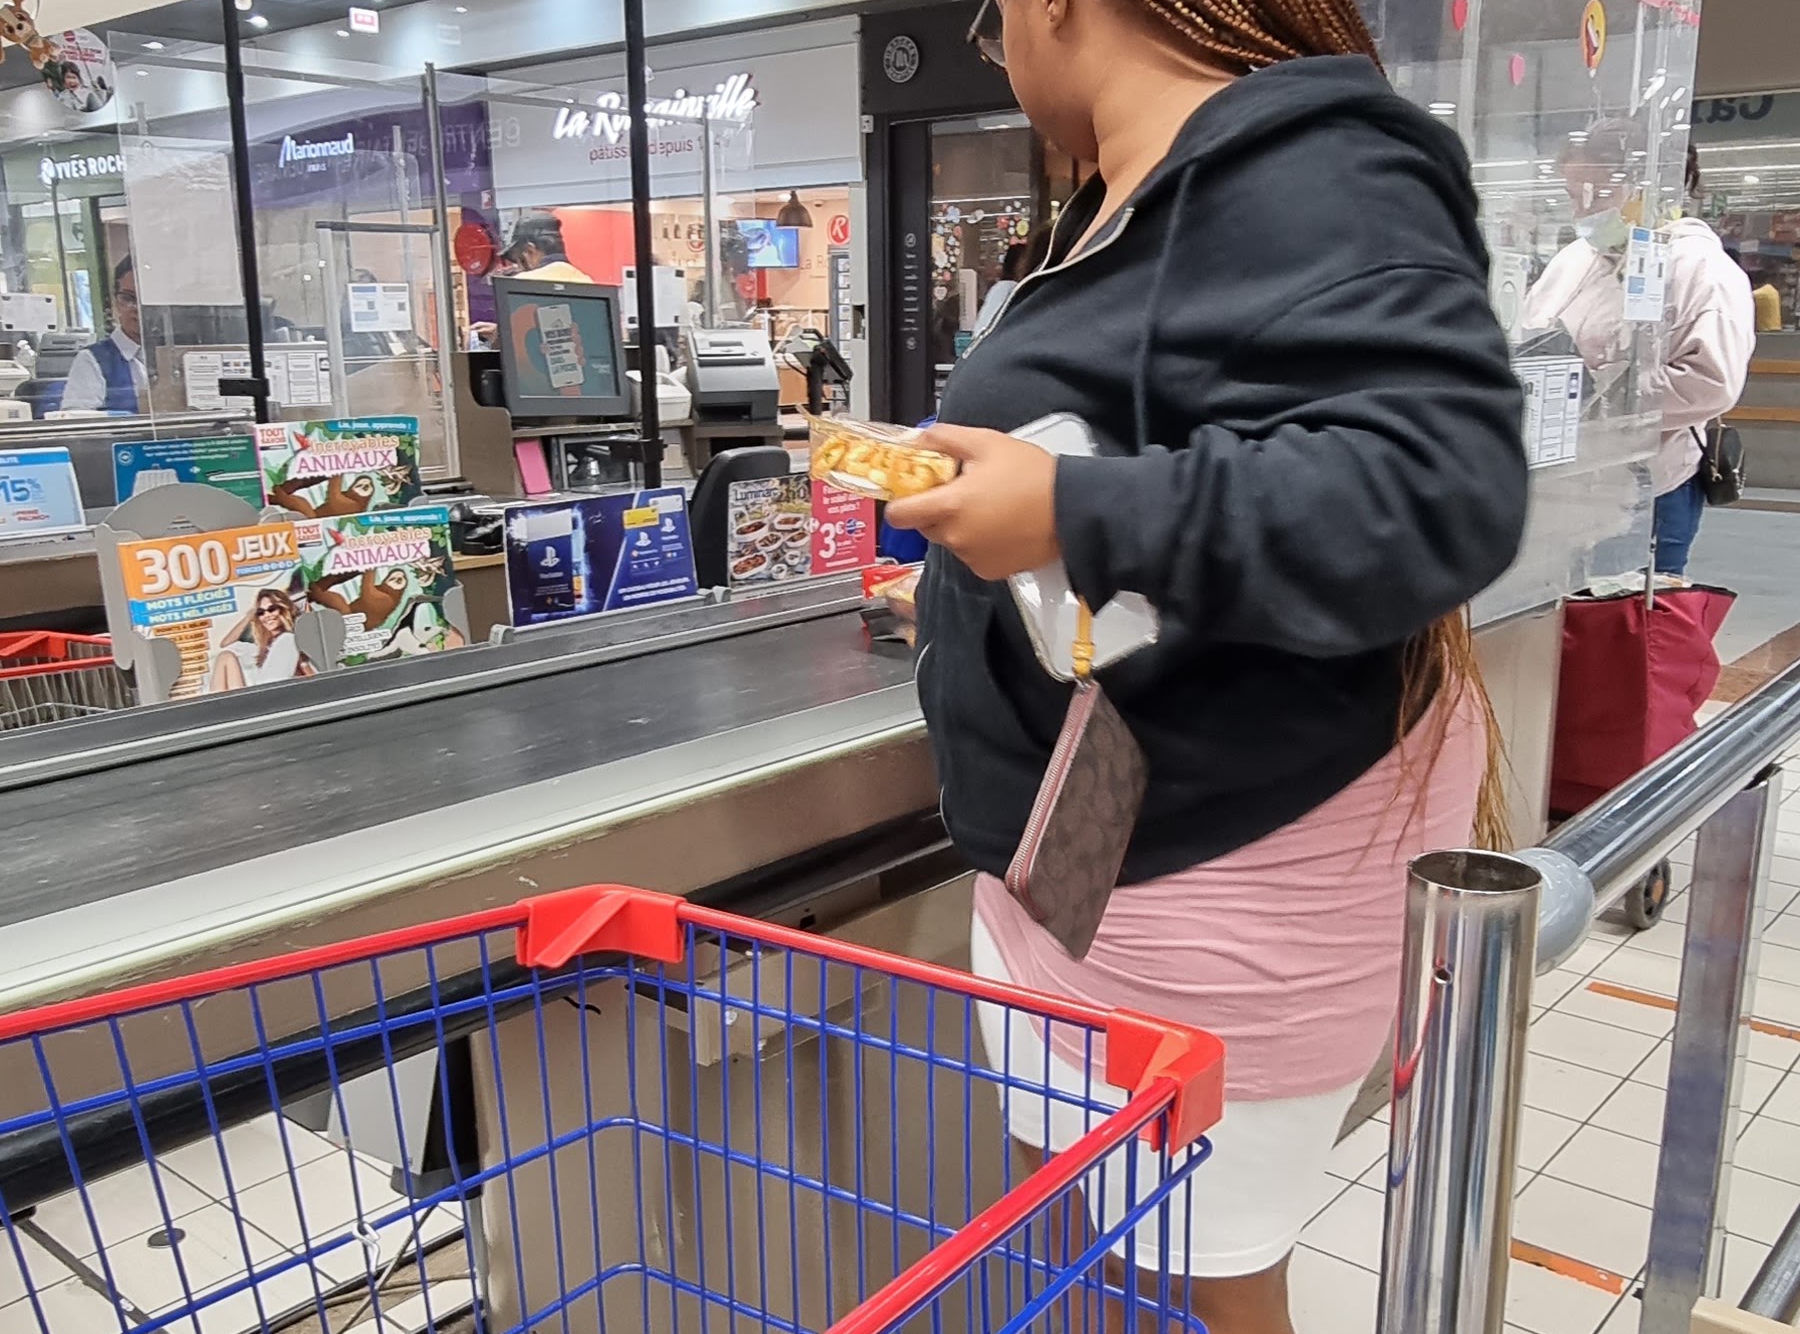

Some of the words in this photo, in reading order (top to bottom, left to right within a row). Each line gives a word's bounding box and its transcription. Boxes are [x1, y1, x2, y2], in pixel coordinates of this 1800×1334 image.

[279, 132, 354, 168] Marionnaud
[260, 427, 285, 437] TOUT
[309, 434, 399, 453] Incroyables
[296, 450, 396, 474] ANIMAUX
[295, 524, 320, 535] TOUT
[344, 528, 432, 548] Incroyables
[135, 540, 231, 594] 300
[232, 531, 294, 562] JEUX
[332, 542, 427, 569] ANIMAUX
[147, 599, 182, 611] MOTS
[149, 611, 182, 624] MOTS
